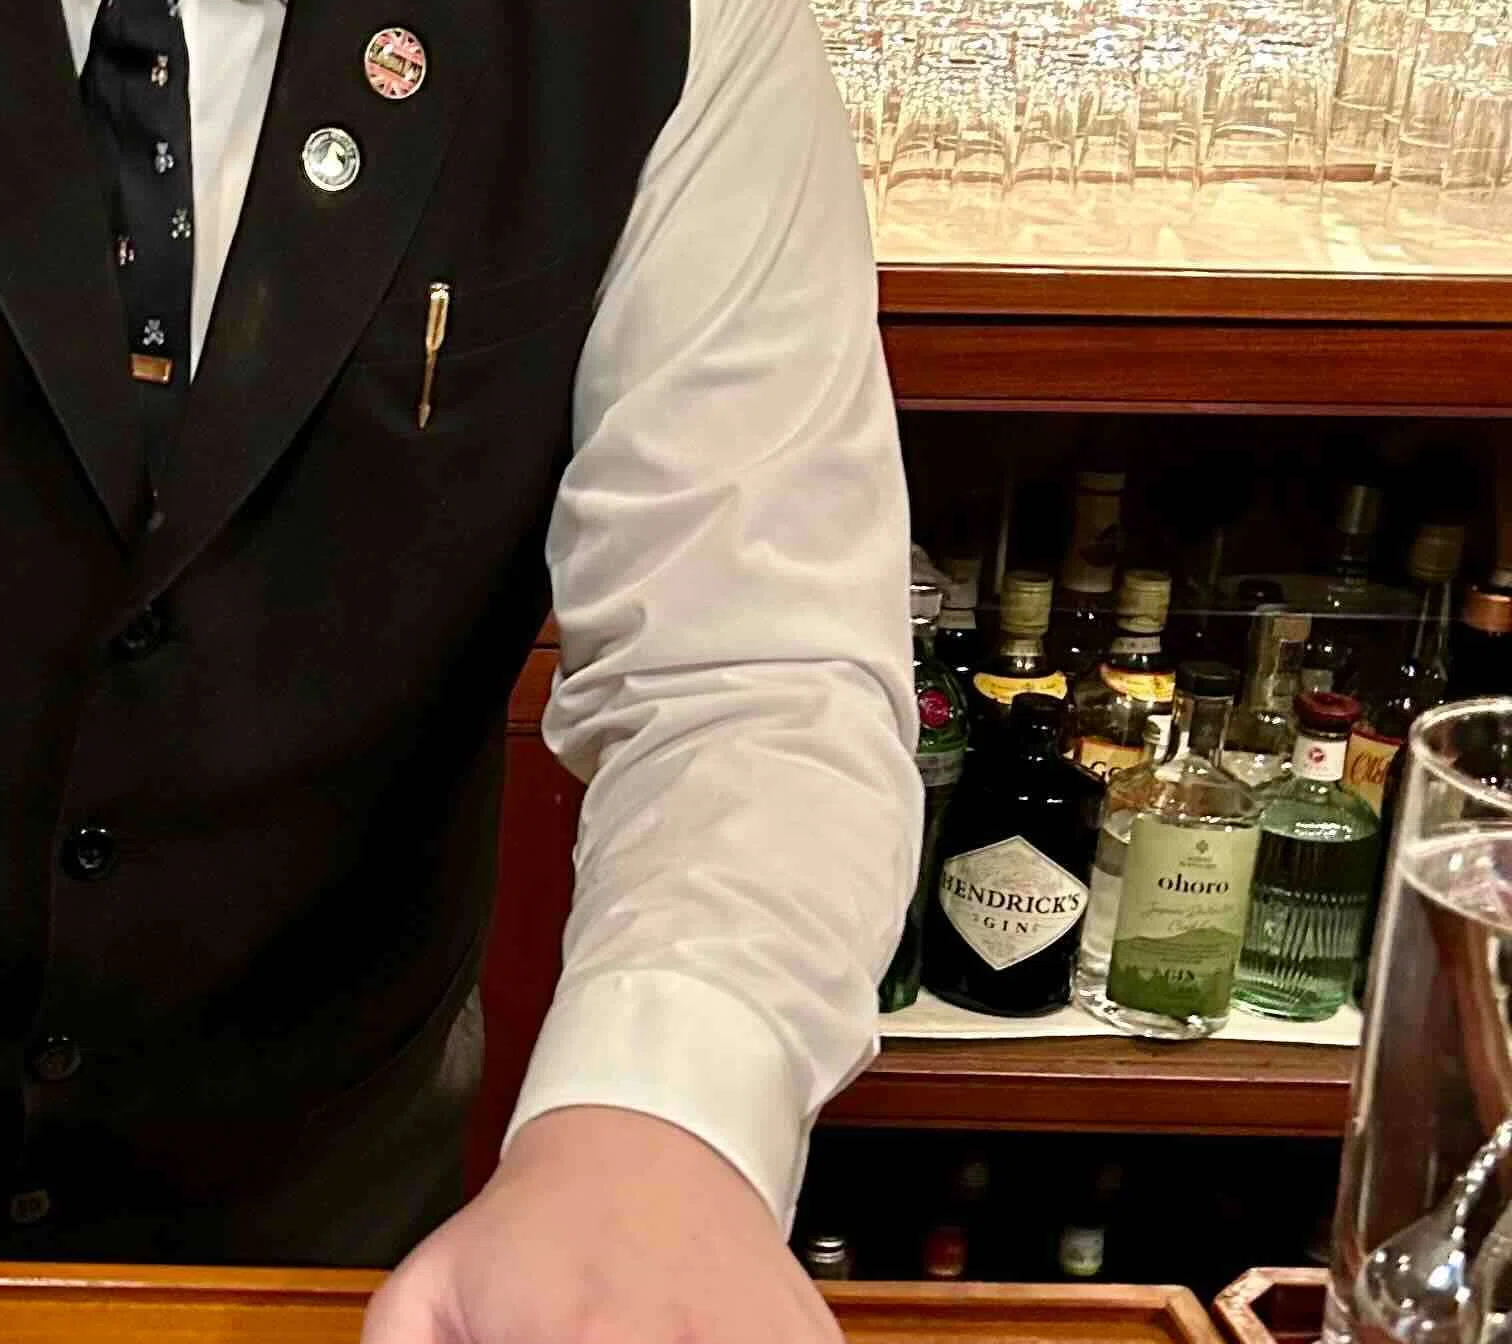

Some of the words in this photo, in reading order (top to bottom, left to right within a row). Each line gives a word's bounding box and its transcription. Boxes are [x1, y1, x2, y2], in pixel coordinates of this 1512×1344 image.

[942, 871, 1081, 914] HENDRICK'S
[1157, 872, 1230, 895] ohoro
[983, 916, 1029, 934] GIN
